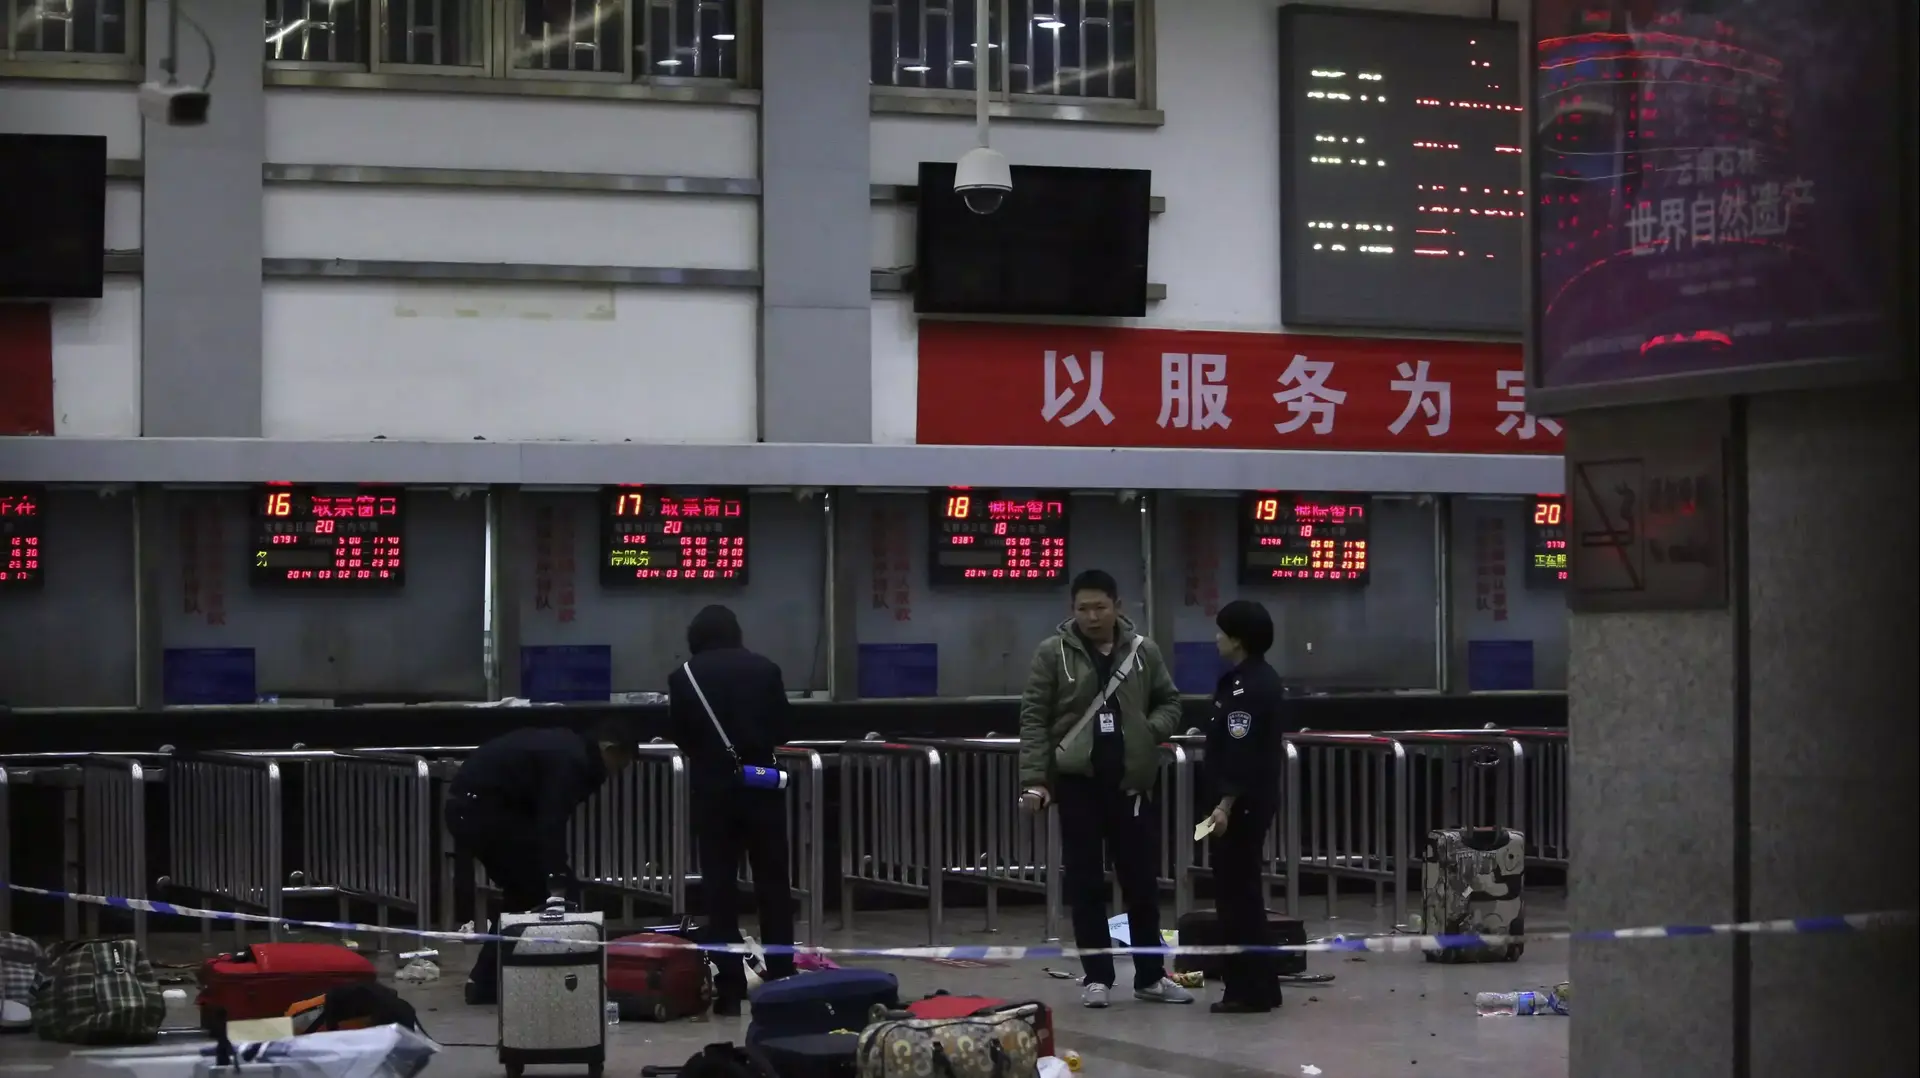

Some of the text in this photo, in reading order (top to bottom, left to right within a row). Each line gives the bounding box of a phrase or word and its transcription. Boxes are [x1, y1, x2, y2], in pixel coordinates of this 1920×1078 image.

[1624, 175, 1816, 256] 世界自然遗产
[1040, 349, 1563, 440] 以服务为宗
[268, 493, 290, 515] 16
[618, 494, 641, 515] 17
[948, 497, 969, 518] 18
[1256, 500, 1277, 520] 19
[1535, 504, 1560, 524] 20
[316, 520, 334, 533] 20
[664, 521, 682, 533] 20
[995, 522, 1007, 534] 18
[1301, 525, 1312, 537] 18
